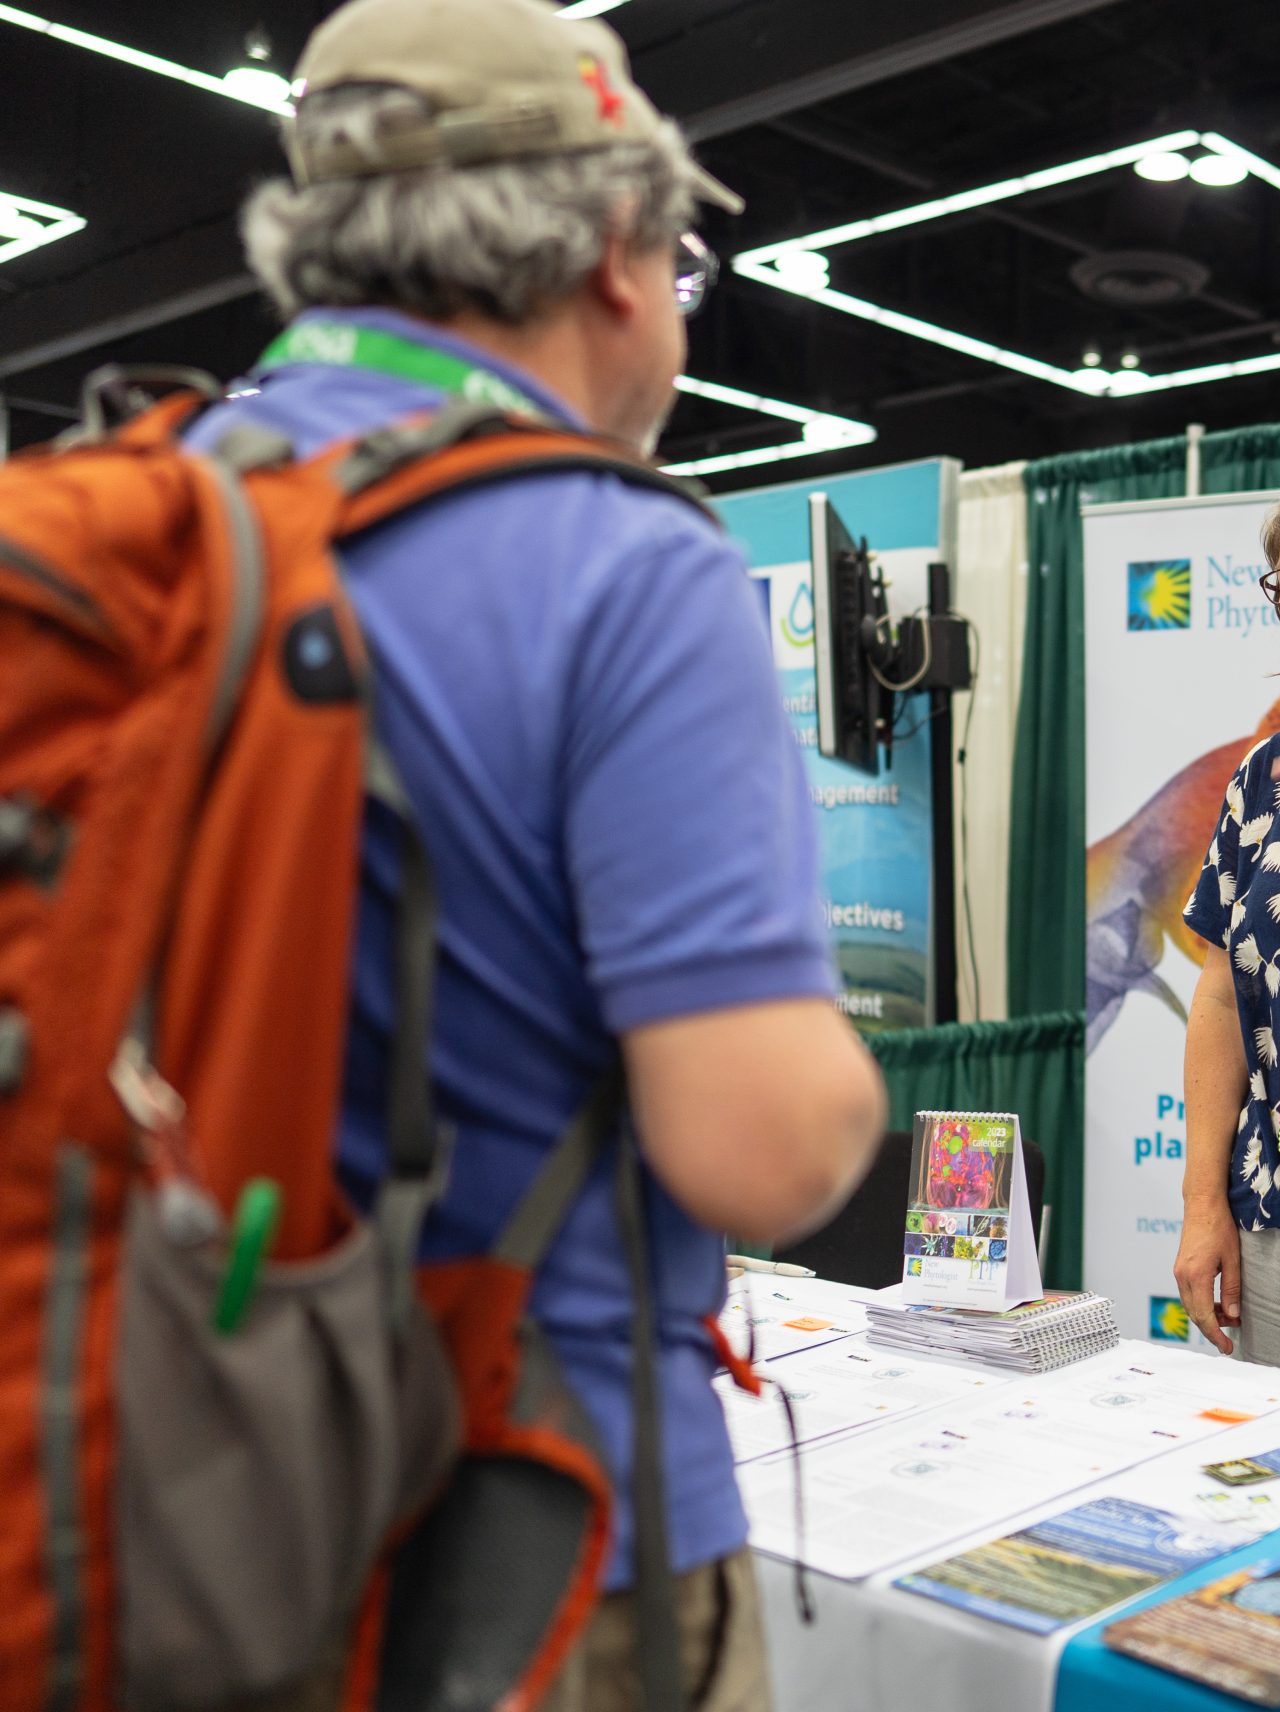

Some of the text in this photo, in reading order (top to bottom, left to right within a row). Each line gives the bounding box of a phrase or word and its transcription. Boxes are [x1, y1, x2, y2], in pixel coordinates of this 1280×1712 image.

[813, 784, 899, 809] agement
[825, 900, 904, 931] jectives
[1157, 1094, 1185, 1120] Pr
[972, 1138, 1006, 1148] calendar
[986, 1127, 1007, 1137] 2023
[1134, 1131, 1182, 1166] pla
